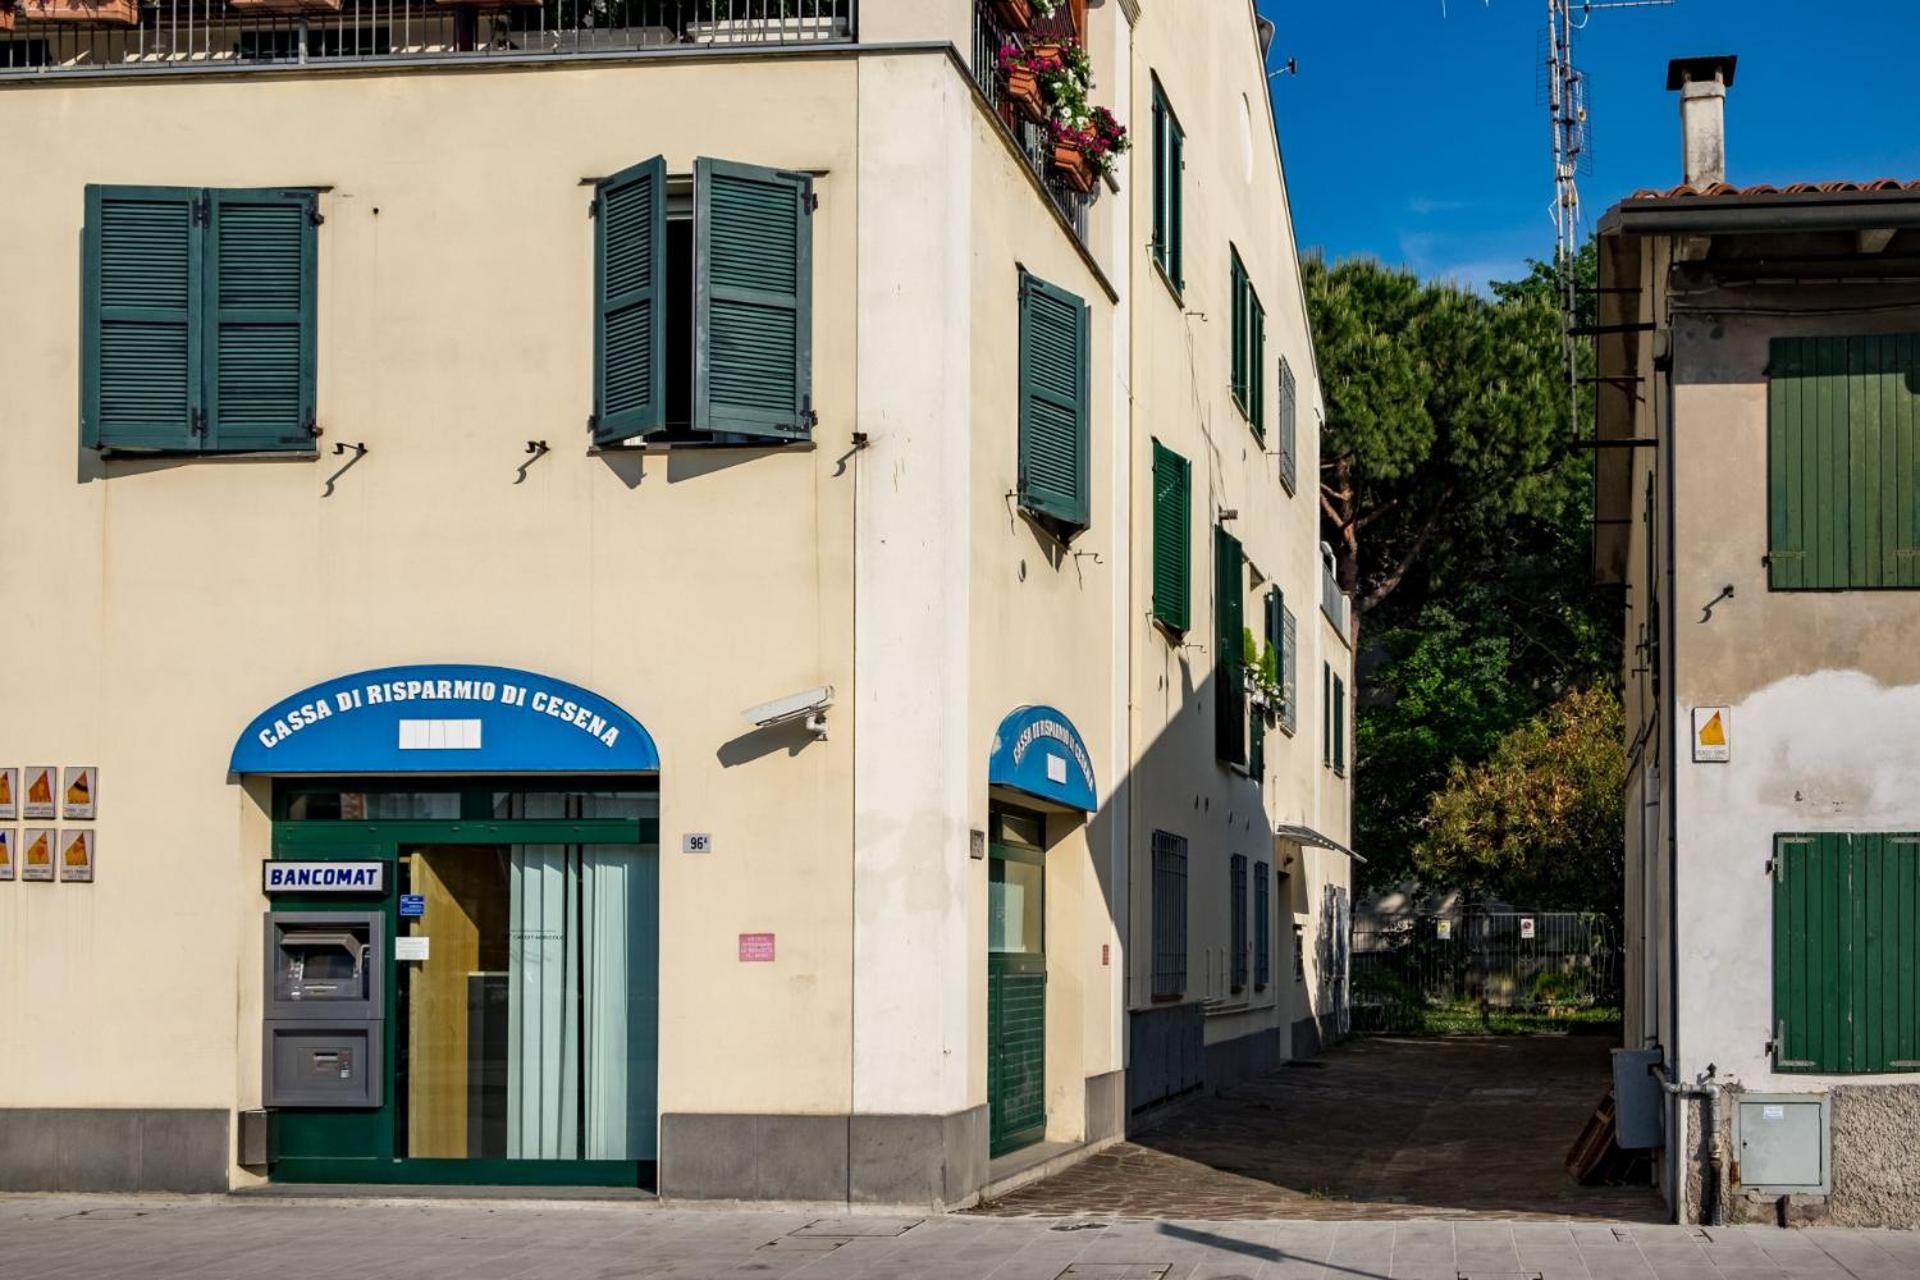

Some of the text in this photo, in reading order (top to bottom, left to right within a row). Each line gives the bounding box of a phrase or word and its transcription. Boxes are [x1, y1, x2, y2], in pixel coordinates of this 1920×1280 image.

[258, 680, 620, 749] CASSA DI RISPARMIO DI CESENA
[271, 869, 377, 886] BANCOMAT
